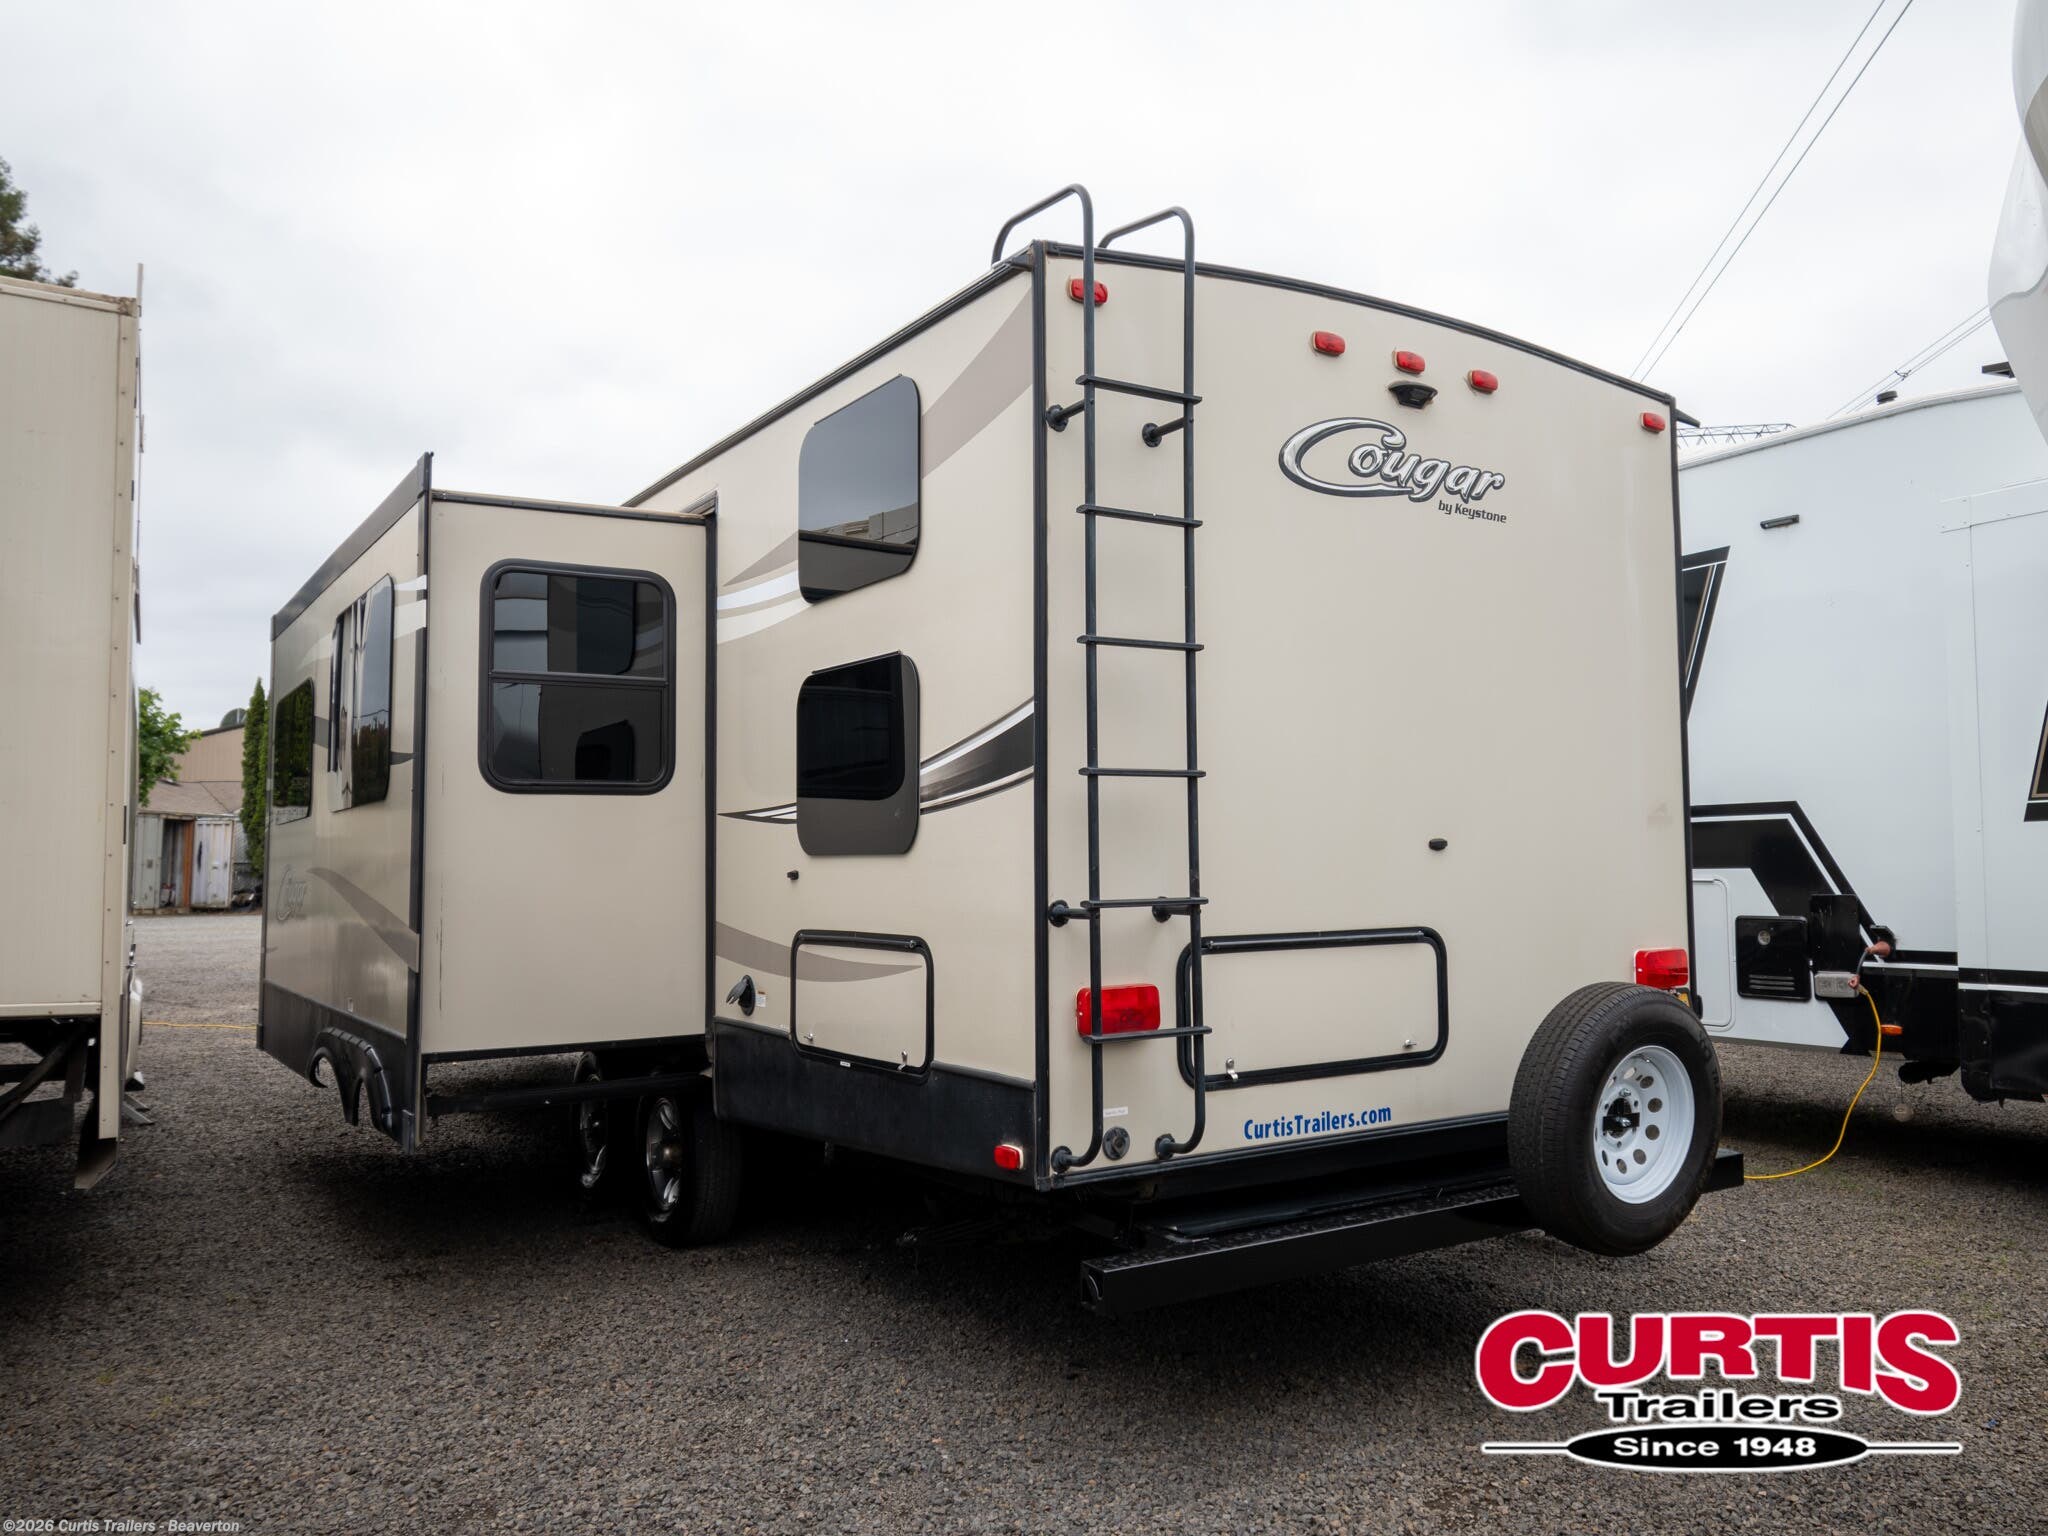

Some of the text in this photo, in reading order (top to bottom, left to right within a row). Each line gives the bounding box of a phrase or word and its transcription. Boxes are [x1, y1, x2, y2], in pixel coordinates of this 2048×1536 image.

[1278, 417, 1505, 503] Cougar
[1438, 500, 1507, 523] by Keystone
[1244, 1106, 1392, 1140] CurtisTrailers.com
